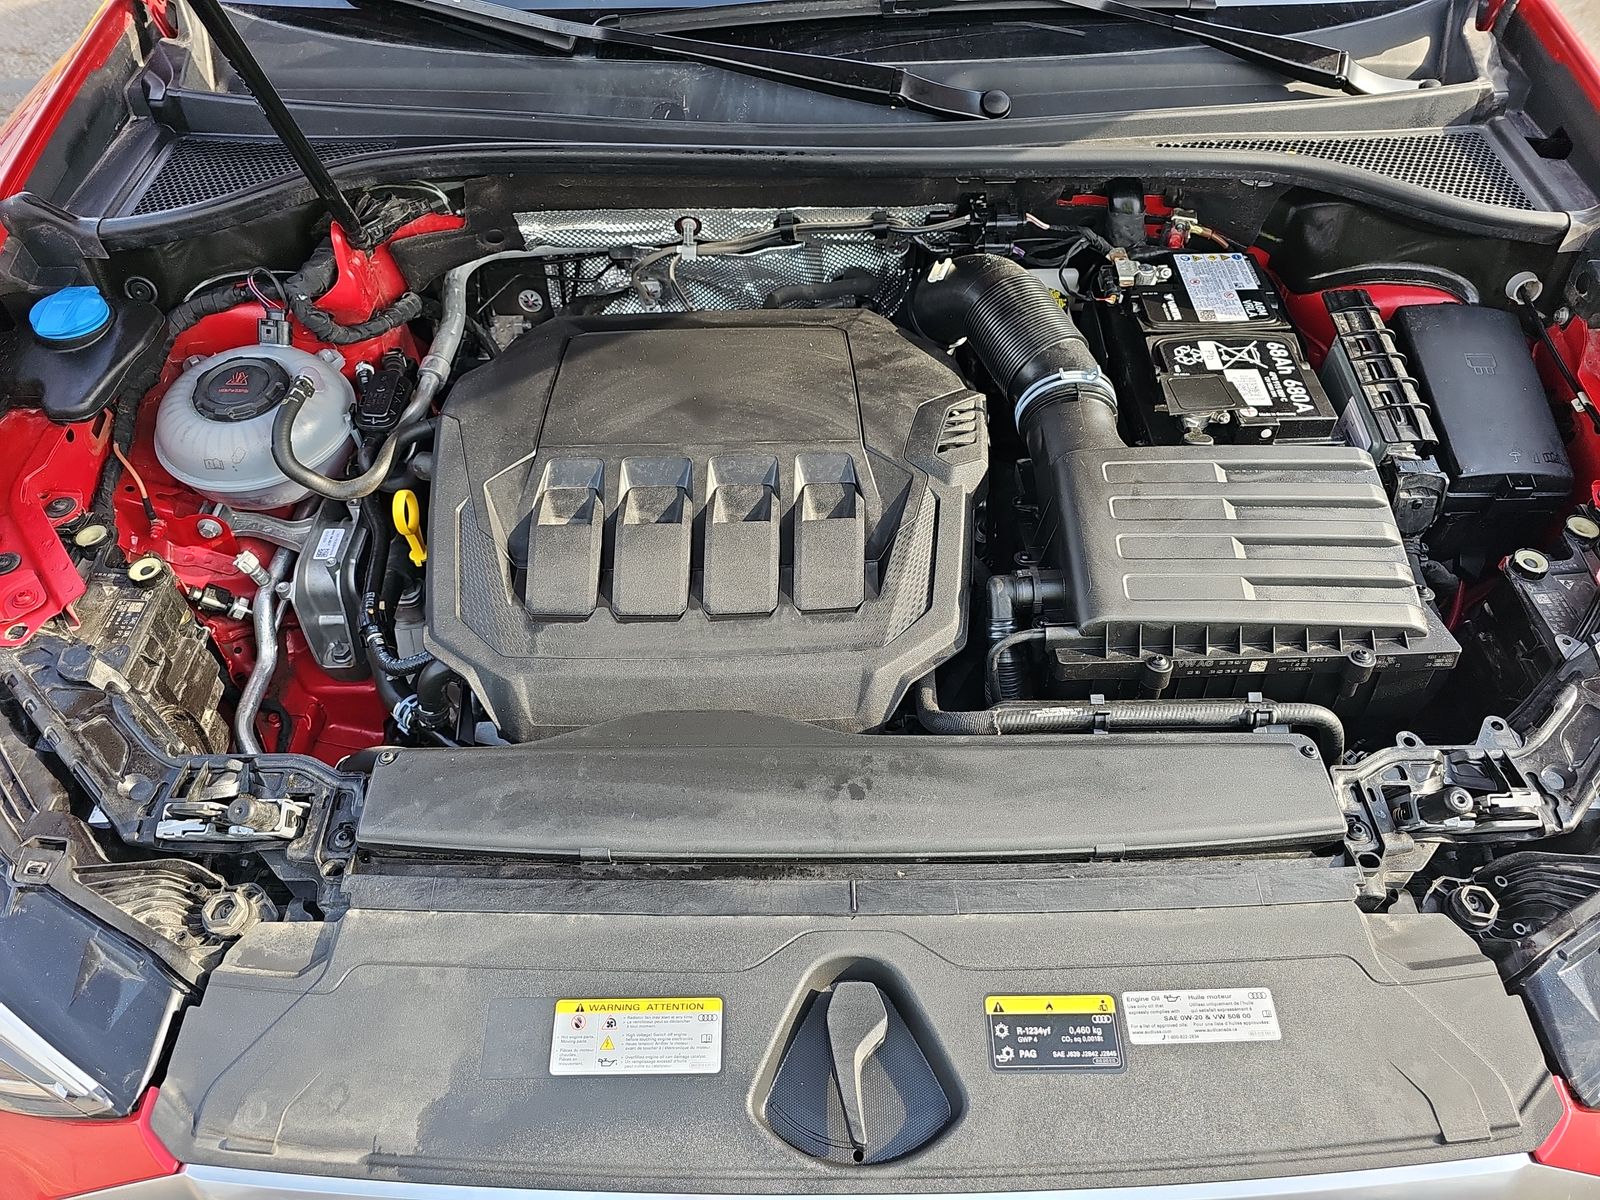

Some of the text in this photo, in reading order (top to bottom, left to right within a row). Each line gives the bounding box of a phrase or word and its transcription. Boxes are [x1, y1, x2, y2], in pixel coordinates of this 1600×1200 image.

[1242, 299, 1258, 318] VRLA
[1252, 300, 1269, 316] AGM
[1266, 342, 1314, 413] 68Ah 680A
[589, 1002, 705, 1011] WARNING ATTENTION
[1017, 1026, 1052, 1036] R-1234yf
[1092, 1025, 1103, 1036] kg
[1019, 1049, 1038, 1058] PAG
